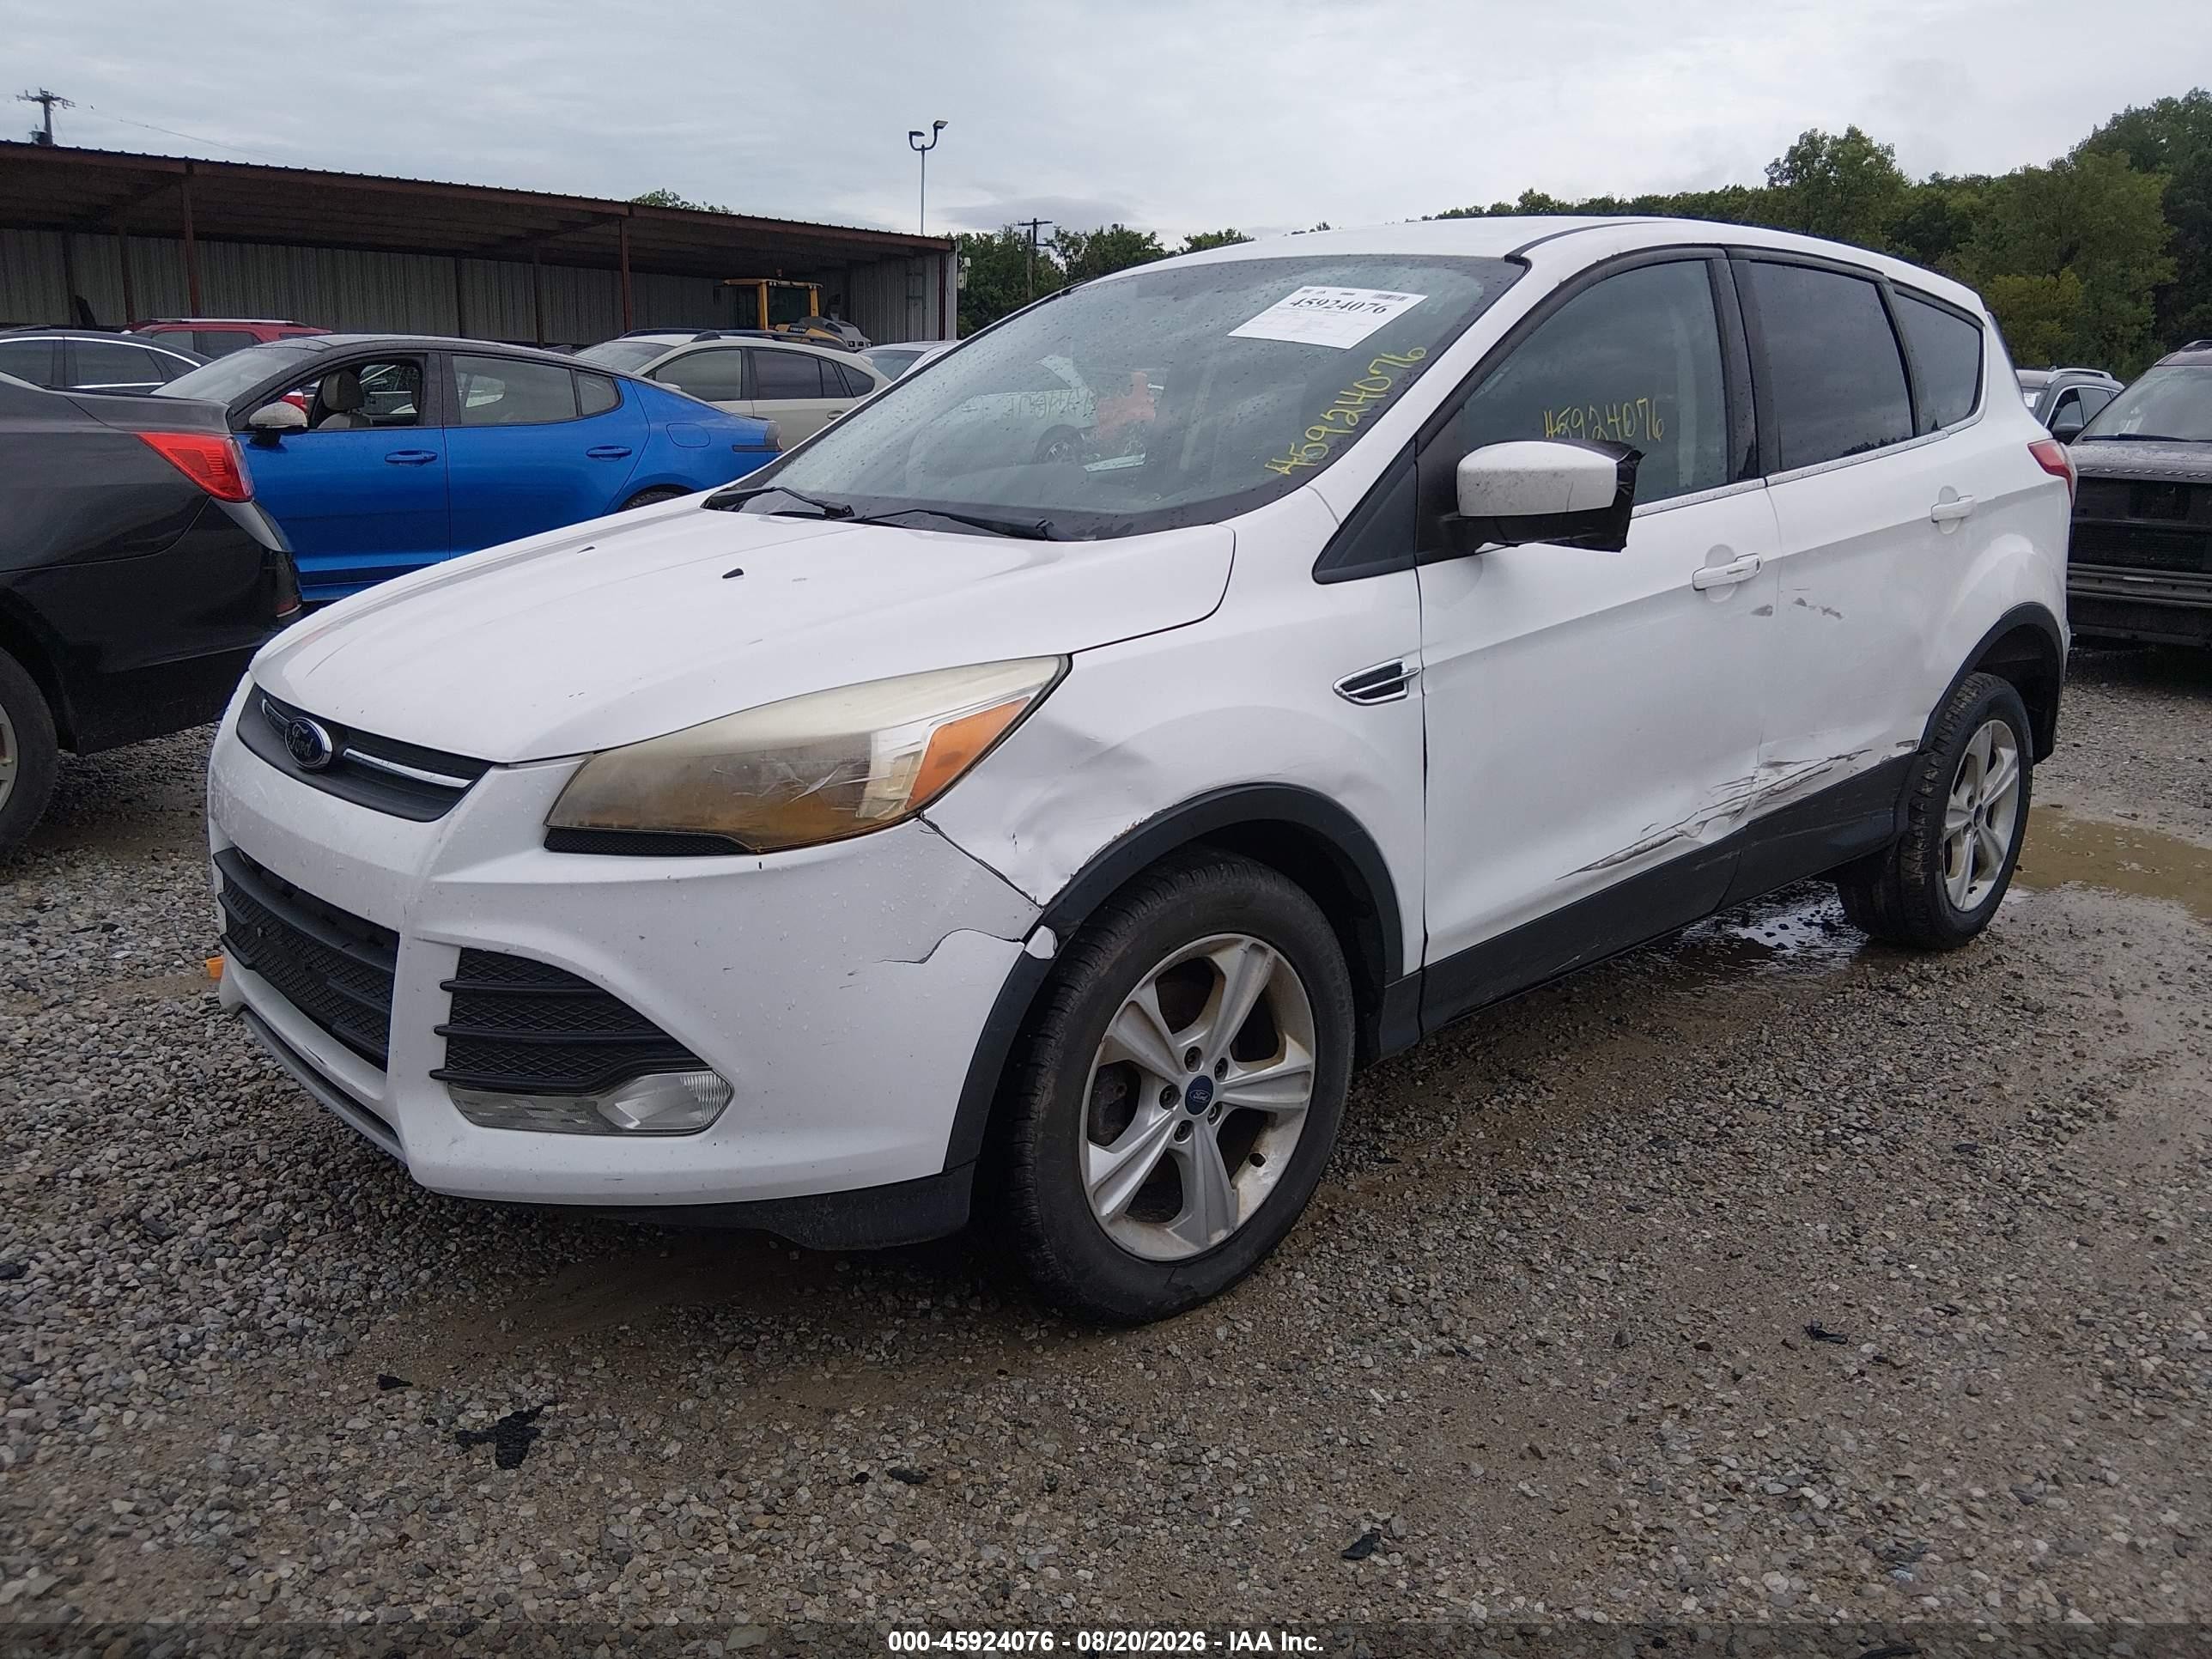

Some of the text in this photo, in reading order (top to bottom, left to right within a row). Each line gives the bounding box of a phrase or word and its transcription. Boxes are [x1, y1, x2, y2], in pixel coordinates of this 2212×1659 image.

[1289, 297, 1389, 314] 45924076
[1265, 347, 1427, 475] 45924076
[1544, 398, 1664, 442] 45924076
[287, 721, 314, 757] Ford
